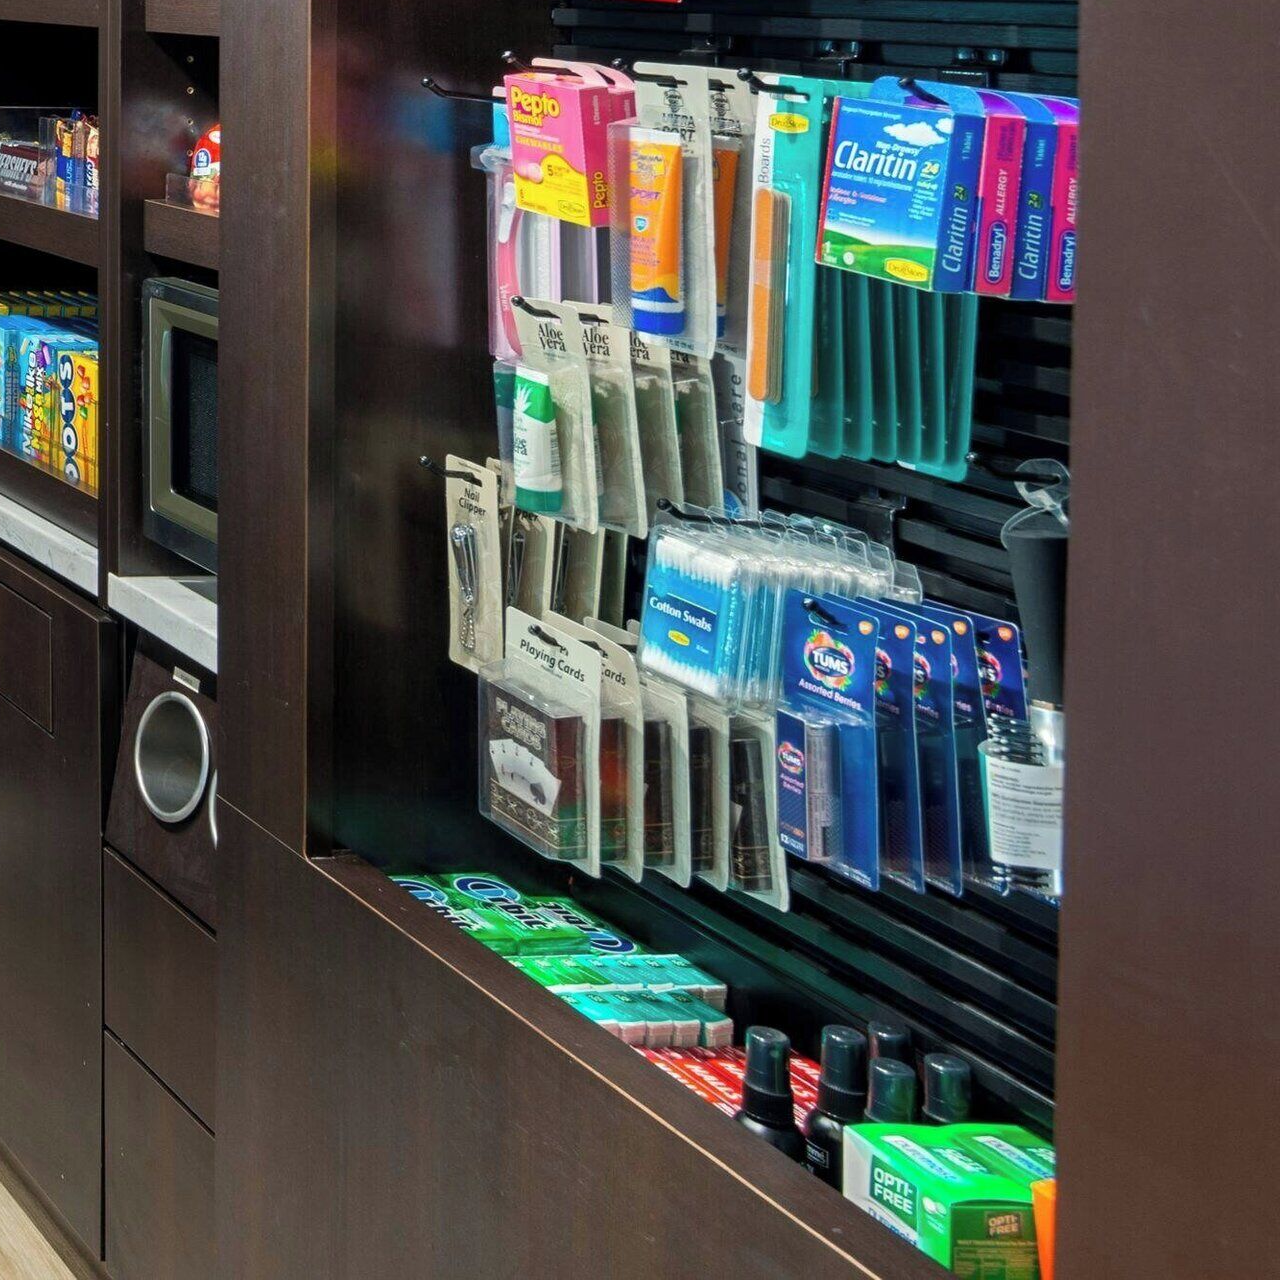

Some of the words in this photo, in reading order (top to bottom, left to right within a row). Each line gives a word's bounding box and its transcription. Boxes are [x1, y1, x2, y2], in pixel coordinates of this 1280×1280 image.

[510, 85, 562, 118] Pepto
[512, 109, 543, 128] Bismol
[546, 165, 554, 177] 5
[757, 137, 772, 185] Boards
[833, 141, 918, 182] Claritin
[921, 160, 940, 175] 24
[592, 170, 605, 209] Pepto
[955, 185, 968, 201] 24
[996, 168, 1009, 216] ALLERGY
[1028, 192, 1041, 208] 24
[942, 205, 968, 273] Claritin
[1018, 214, 1042, 280] Claritin
[987, 227, 1005, 280] Benadryl
[1059, 236, 1076, 286] Benadryl
[538, 323, 564, 342] Aloe
[539, 336, 567, 354] Vera
[582, 324, 610, 345] Aloe
[583, 340, 611, 357] Vera
[458, 498, 487, 518] Clipper
[463, 488, 481, 503] Nail
[649, 596, 682, 619] Cotton
[683, 609, 713, 633] Swabs
[519, 638, 557, 670] Playing
[557, 659, 587, 684] Cards
[812, 650, 850, 676] TUMS
[798, 677, 833, 700] Assorted
[833, 694, 862, 712] Berries
[781, 750, 803, 767] TUMS
[873, 1166, 914, 1197] OPTI-
[873, 1182, 914, 1216] FREE
[987, 1214, 1018, 1227] OPTI-
[988, 1224, 1019, 1236] FREE
